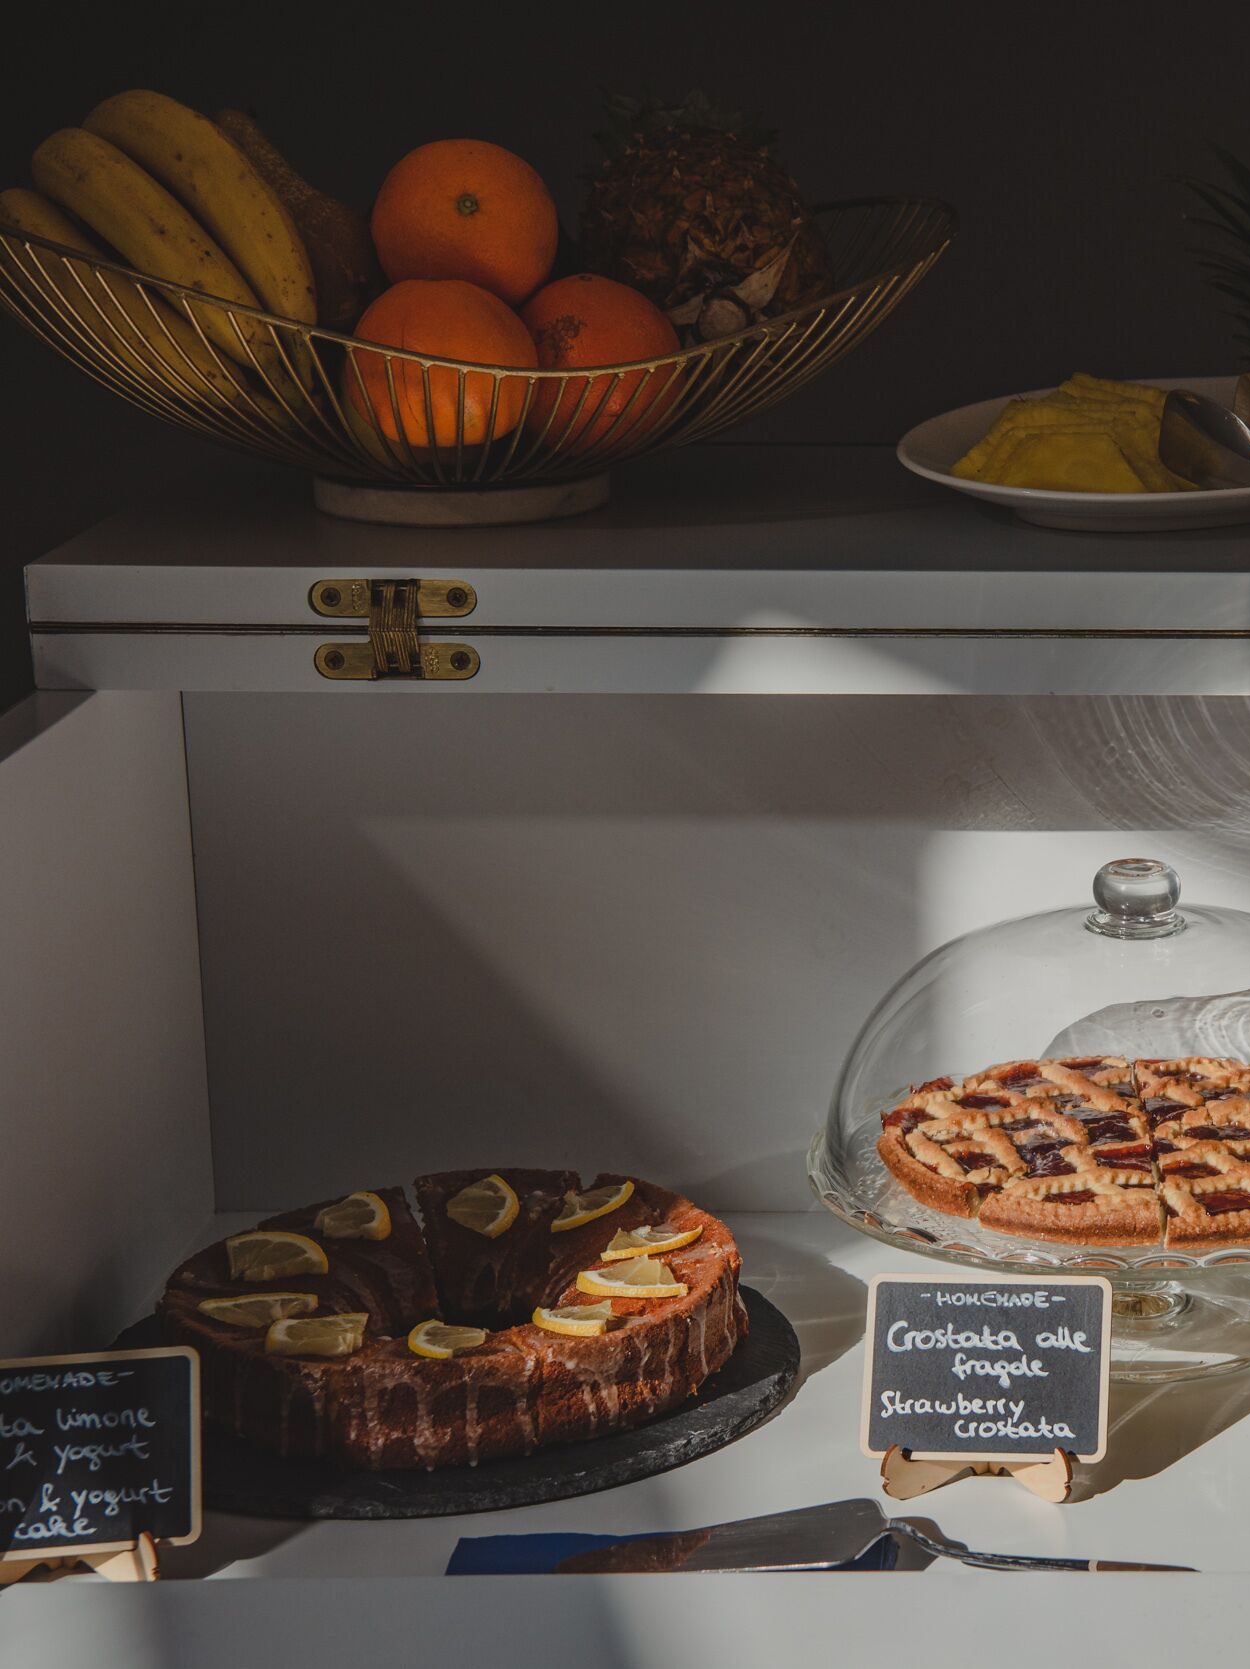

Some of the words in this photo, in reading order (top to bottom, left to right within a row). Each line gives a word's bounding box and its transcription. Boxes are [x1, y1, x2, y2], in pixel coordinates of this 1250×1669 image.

[886, 1320, 1024, 1352] Crostata
[1035, 1325, 1096, 1353] alle
[951, 1352, 1050, 1389] fragole
[56, 1407, 157, 1431] limone
[880, 1390, 1025, 1421] Strawberry
[53, 1434, 150, 1475] yogurt
[70, 1478, 174, 1519] yogurt
[13, 1514, 98, 1539] cake
